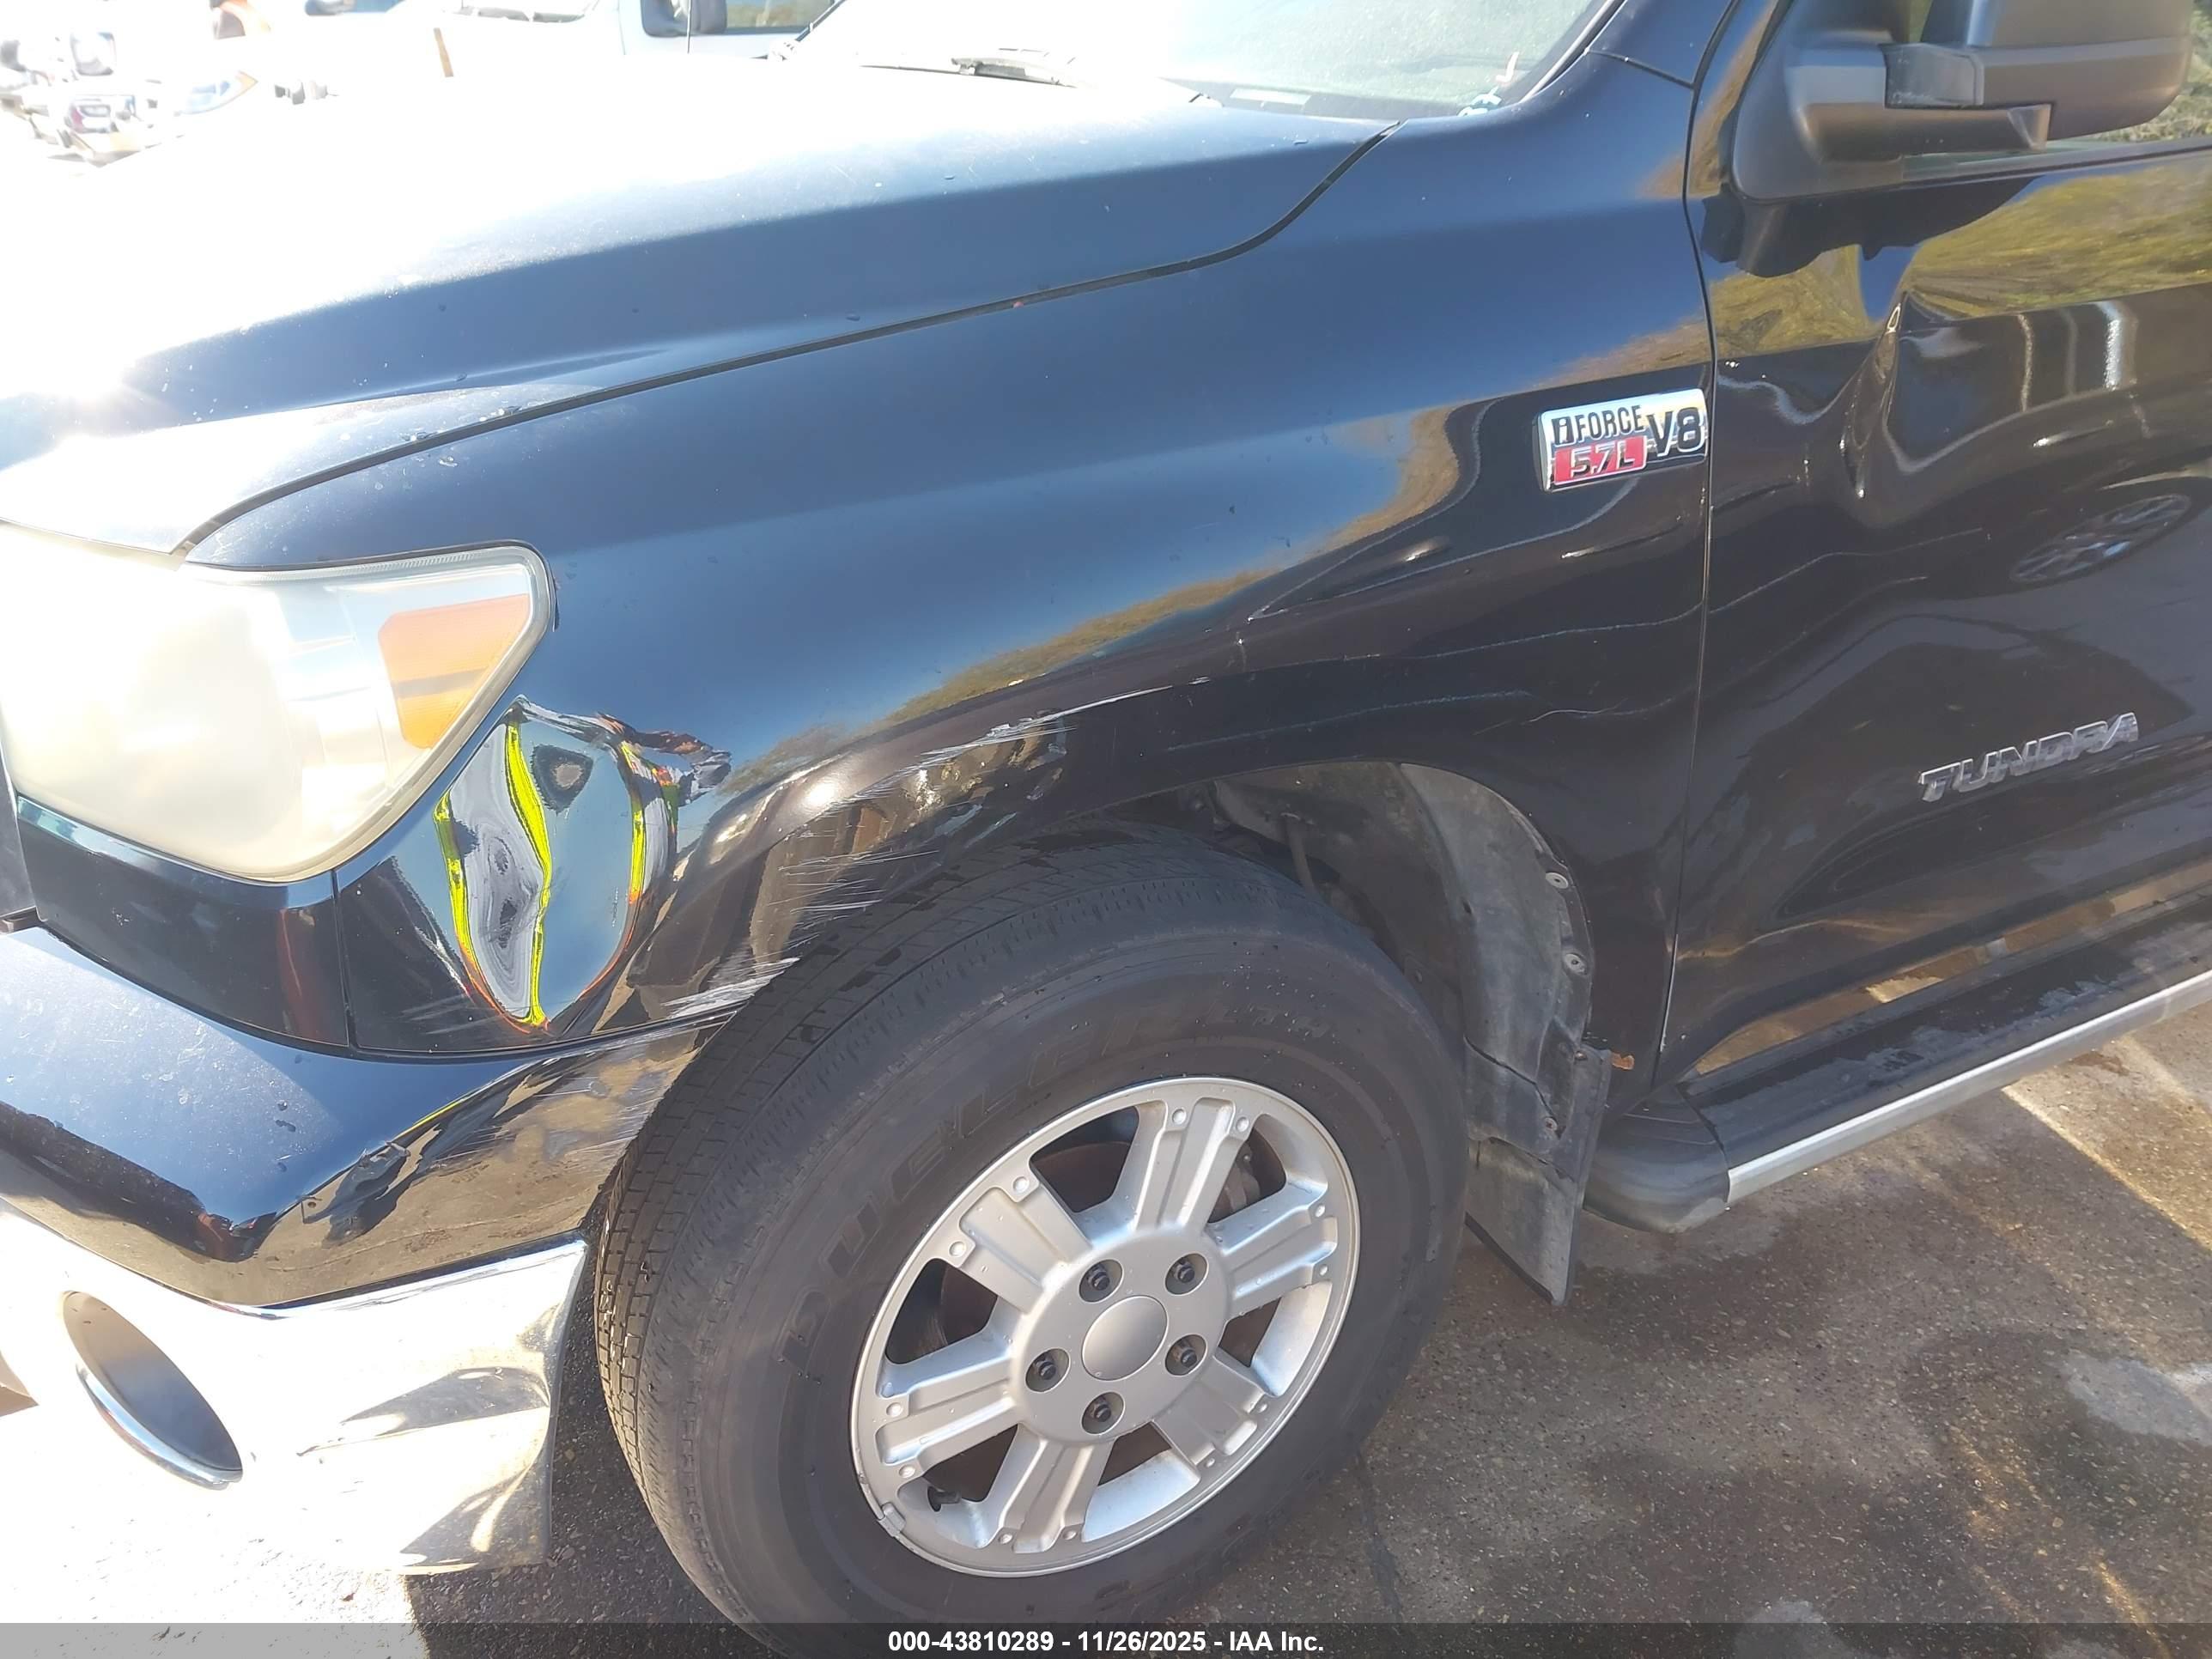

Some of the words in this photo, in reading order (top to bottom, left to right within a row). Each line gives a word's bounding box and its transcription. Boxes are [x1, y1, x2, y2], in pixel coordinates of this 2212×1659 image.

[1646, 406, 1704, 457] V8
[1569, 438, 1637, 478] 5.7L
[1917, 712, 2138, 802] TUNDRA
